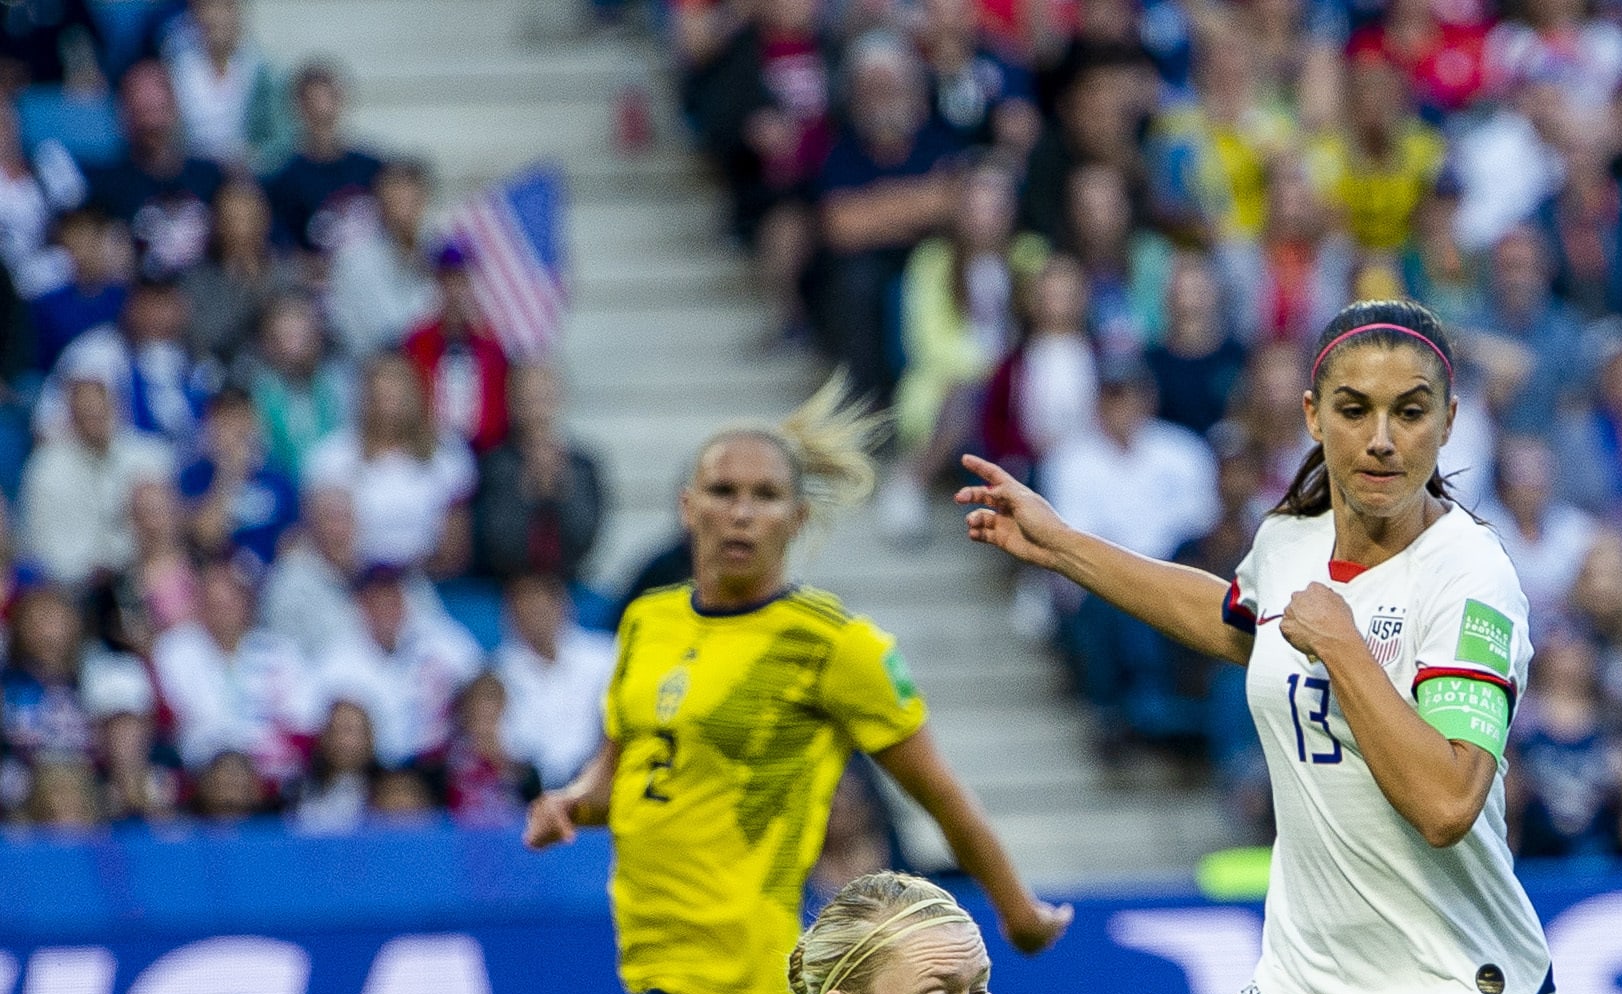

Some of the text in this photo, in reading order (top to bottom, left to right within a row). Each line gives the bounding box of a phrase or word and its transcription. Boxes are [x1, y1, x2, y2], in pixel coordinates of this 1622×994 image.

[1371, 619, 1403, 641] USA
[1286, 672, 1343, 765] 13
[1469, 716, 1500, 741] FIFA
[643, 728, 677, 804] 2
